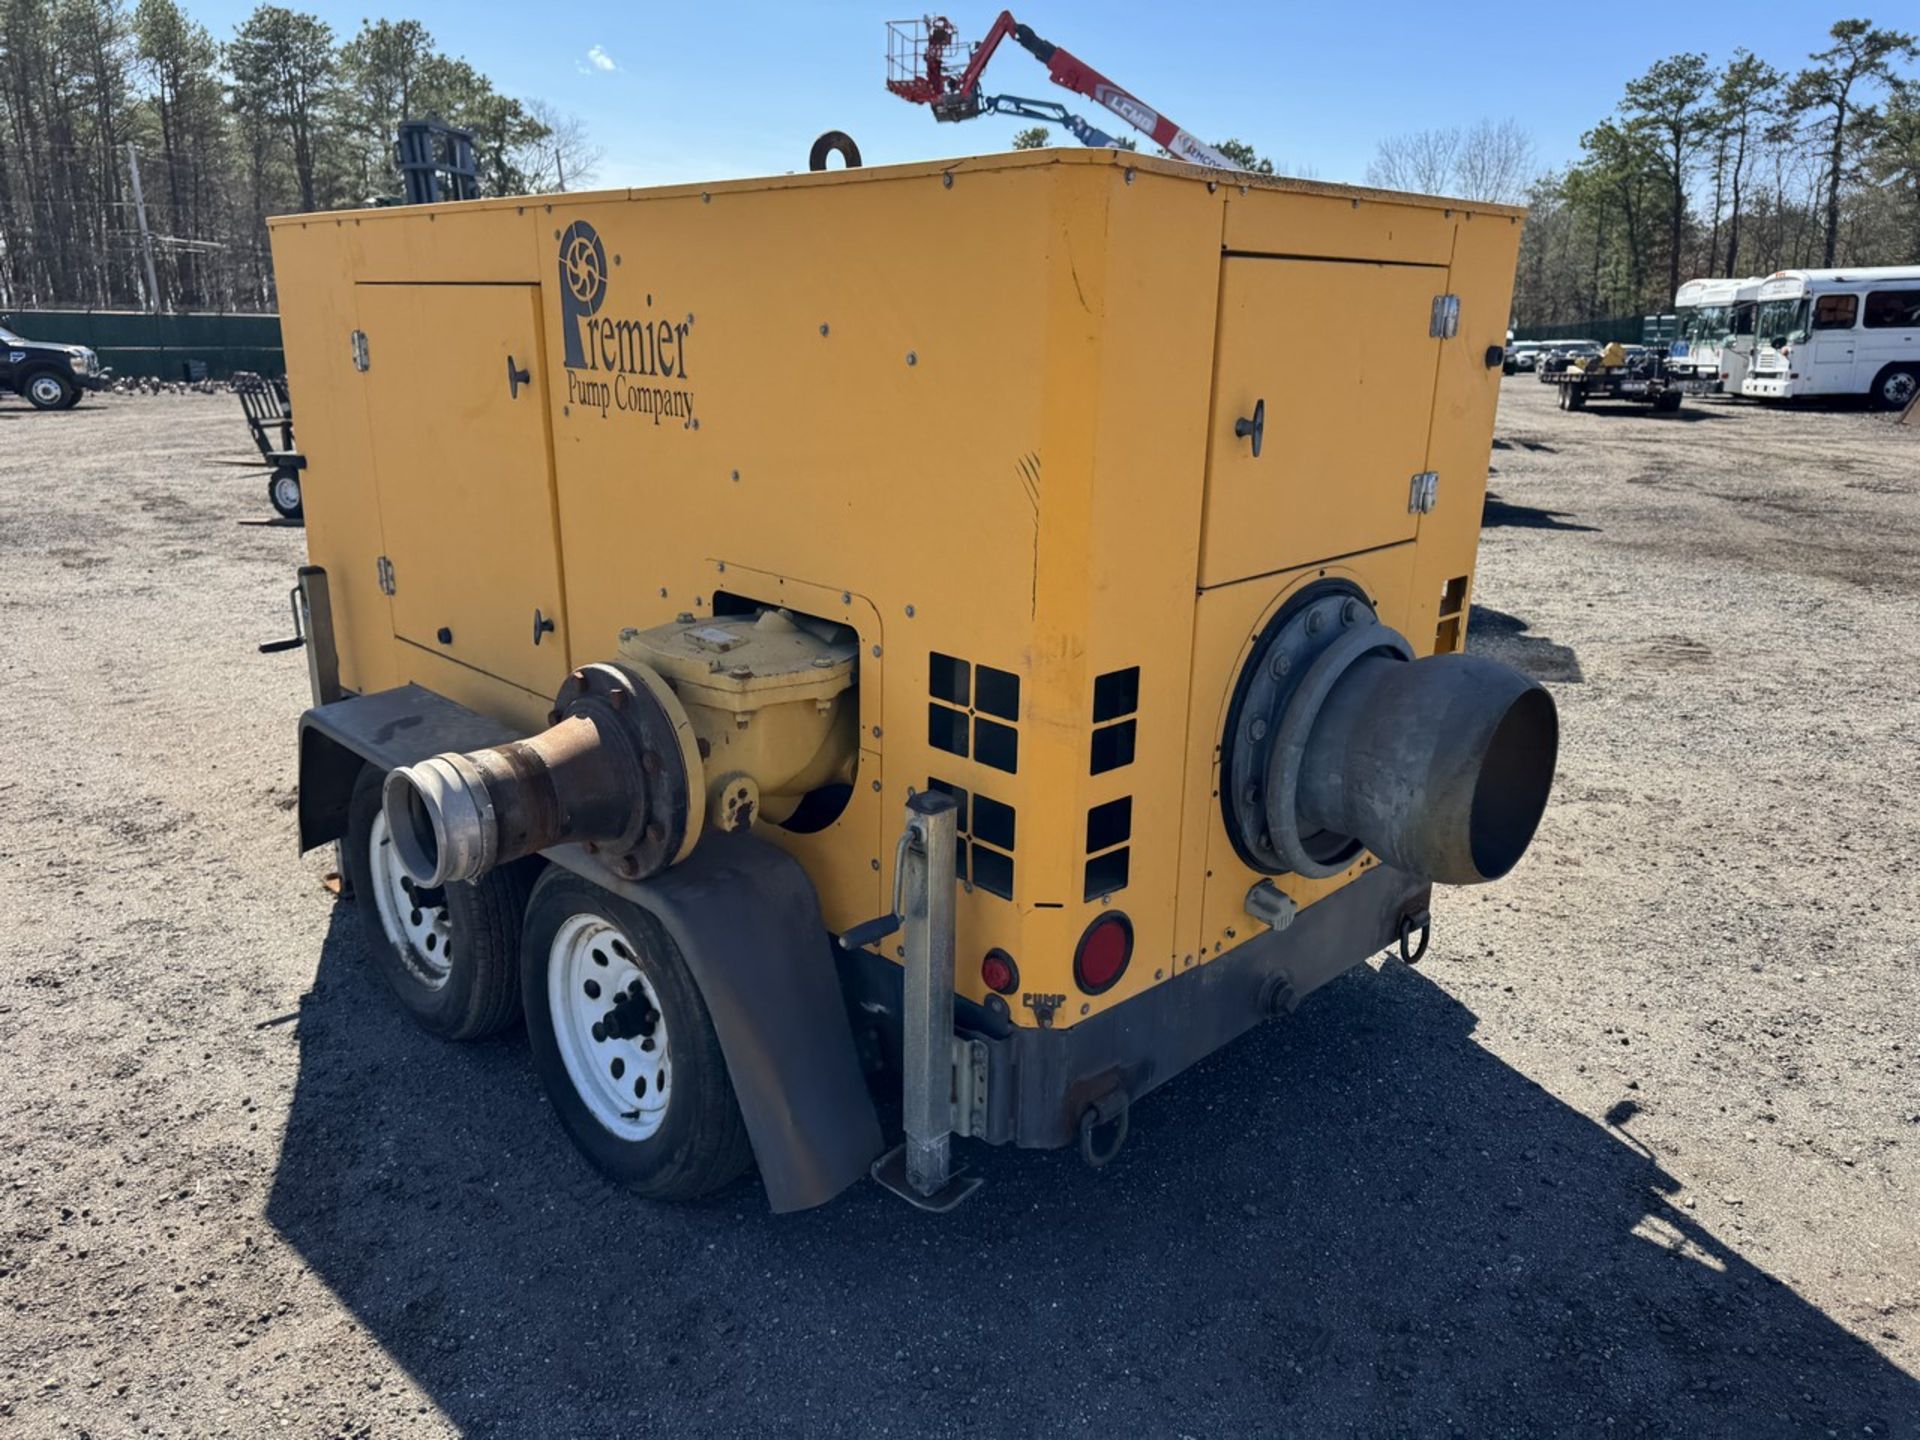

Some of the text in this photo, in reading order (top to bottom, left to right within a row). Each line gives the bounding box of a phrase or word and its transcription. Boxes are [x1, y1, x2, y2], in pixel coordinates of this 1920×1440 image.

[559, 220, 689, 379] Premier
[567, 370, 694, 429] Pump Company
